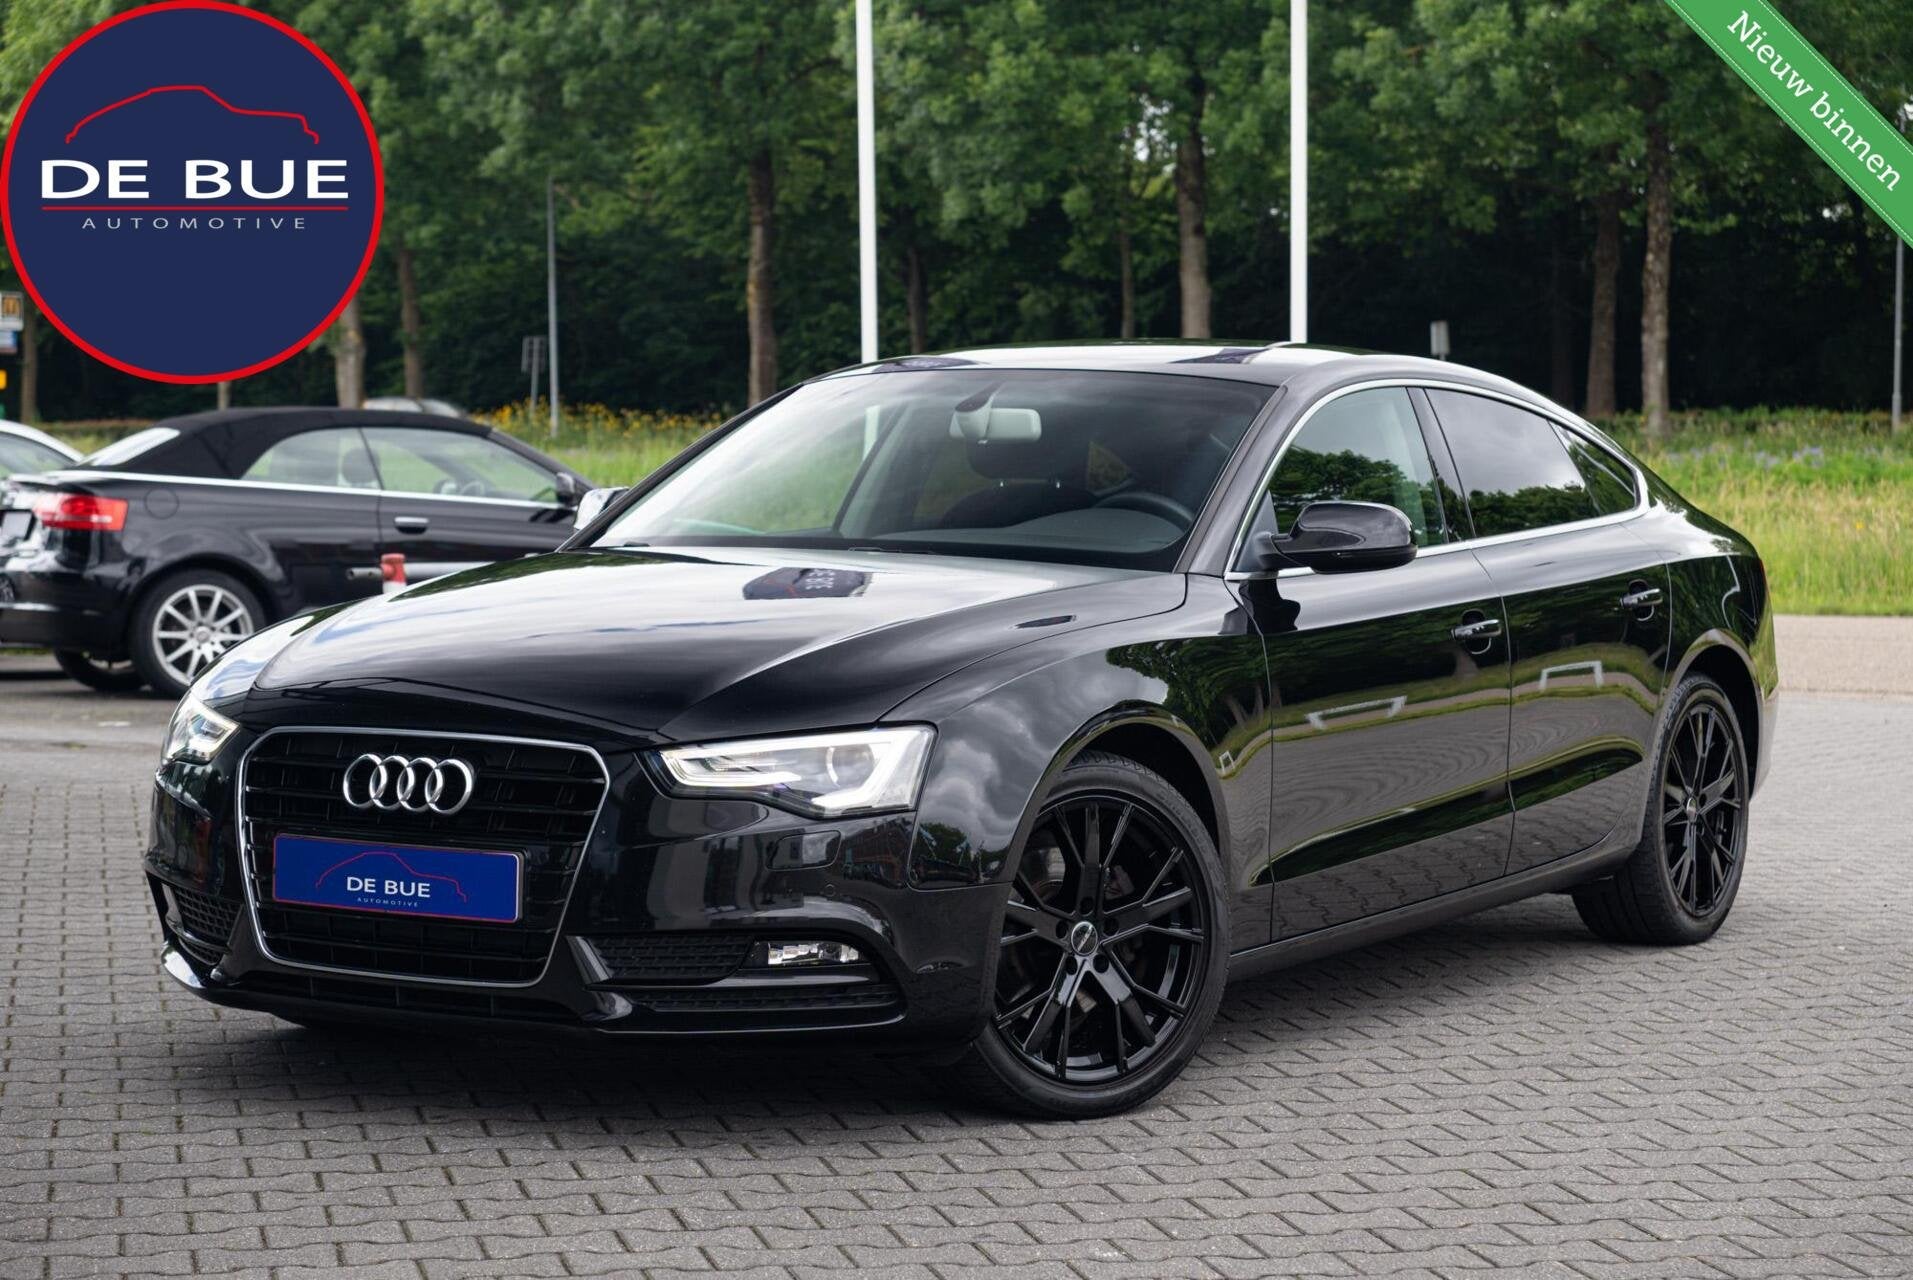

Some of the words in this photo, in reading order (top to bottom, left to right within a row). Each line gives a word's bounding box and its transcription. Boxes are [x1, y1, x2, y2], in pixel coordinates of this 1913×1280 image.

[346, 876, 376, 893] DE
[384, 880, 431, 898] BUE
[357, 897, 418, 907] AUTOMOTIVE
